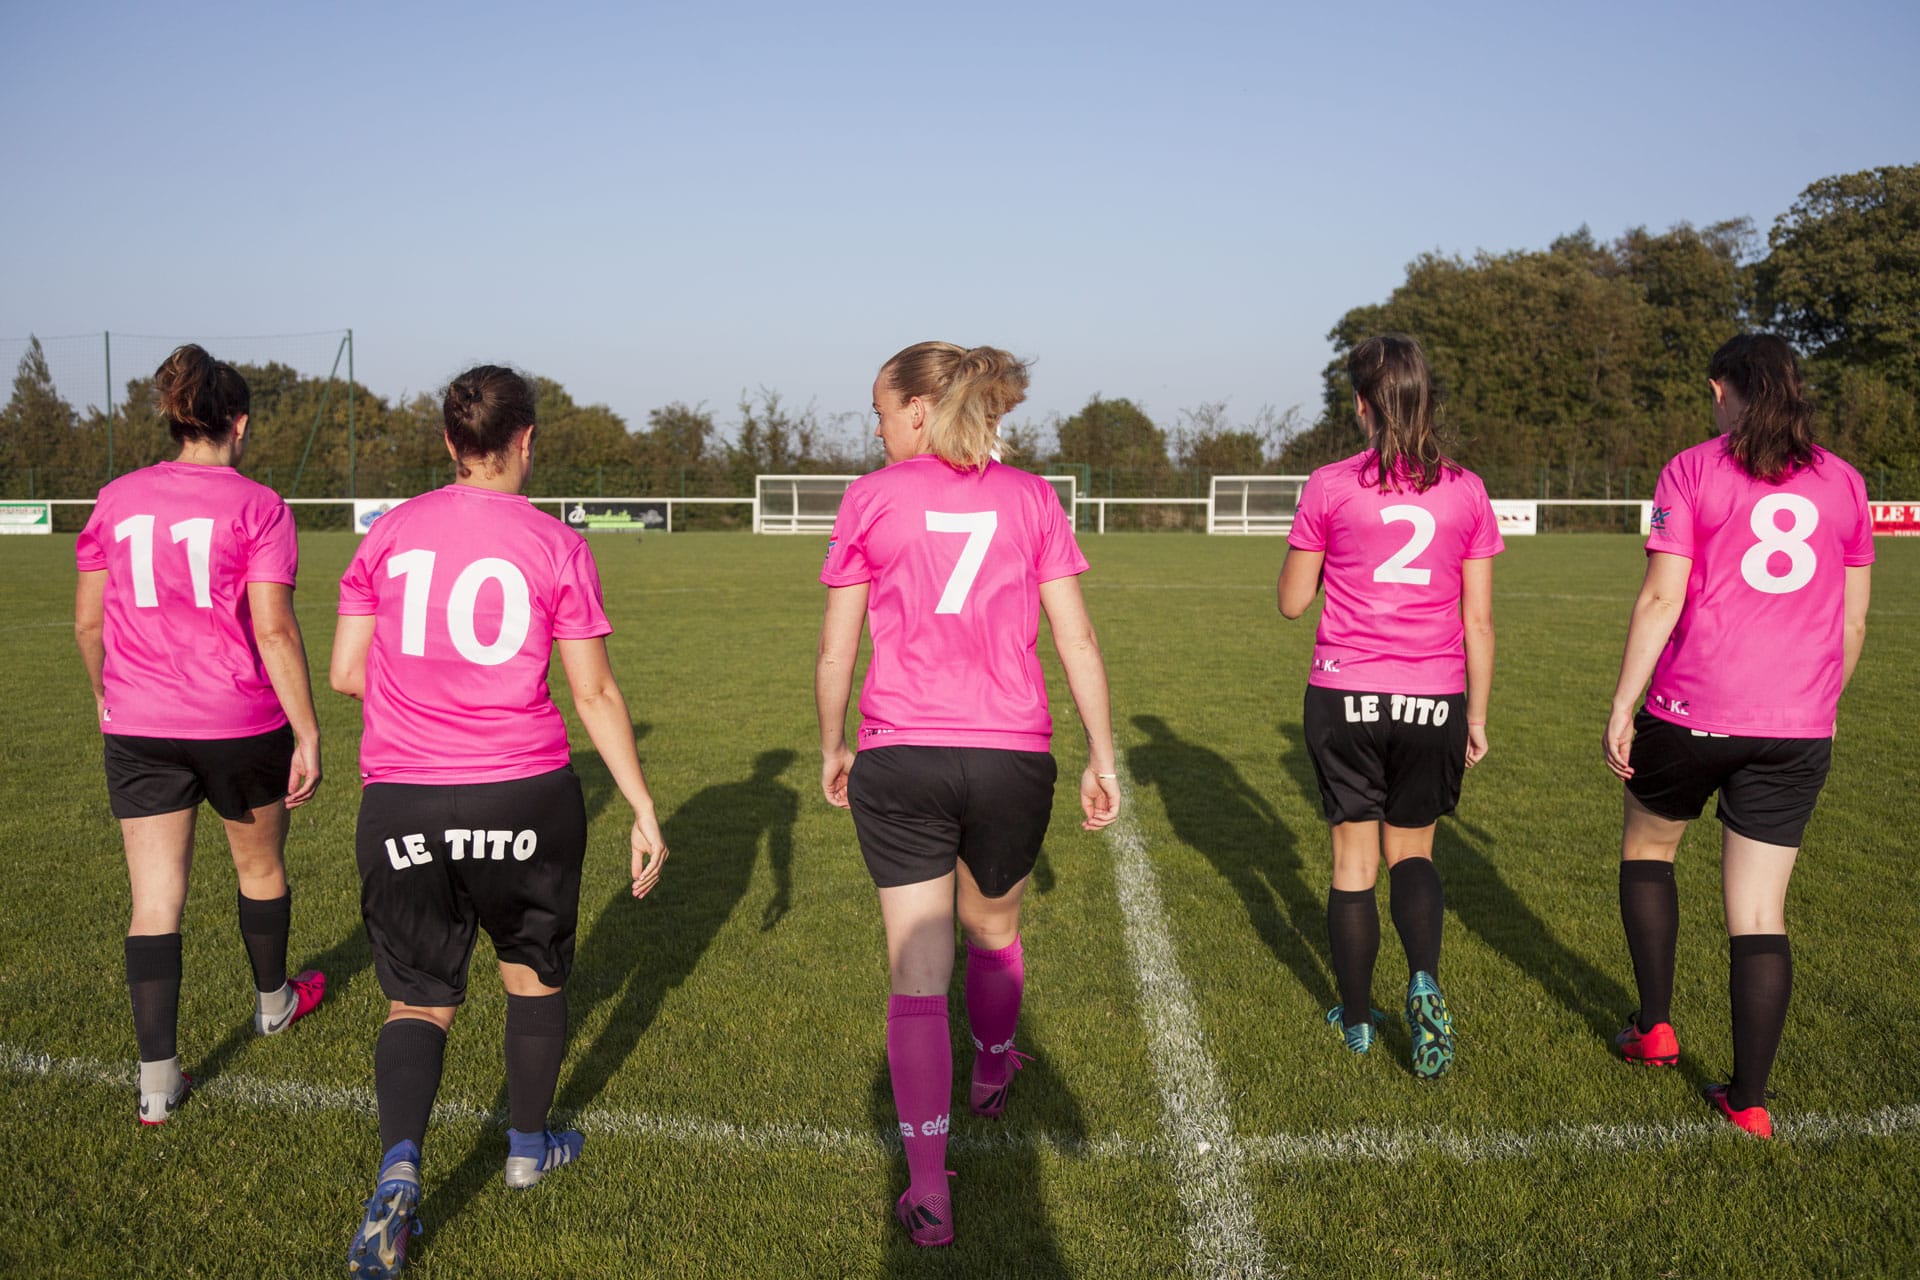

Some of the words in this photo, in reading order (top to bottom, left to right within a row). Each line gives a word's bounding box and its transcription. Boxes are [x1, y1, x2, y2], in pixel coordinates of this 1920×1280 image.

[1373, 504, 1436, 585] 2
[1740, 492, 1819, 594] 8
[1875, 505, 1905, 522] LE
[114, 514, 214, 609] 11
[925, 510, 998, 615] 7
[387, 548, 531, 666] 10
[1343, 695, 1380, 722] LE
[1391, 694, 1450, 727] TITO
[384, 833, 433, 871] LE
[444, 829, 538, 861] TITO
